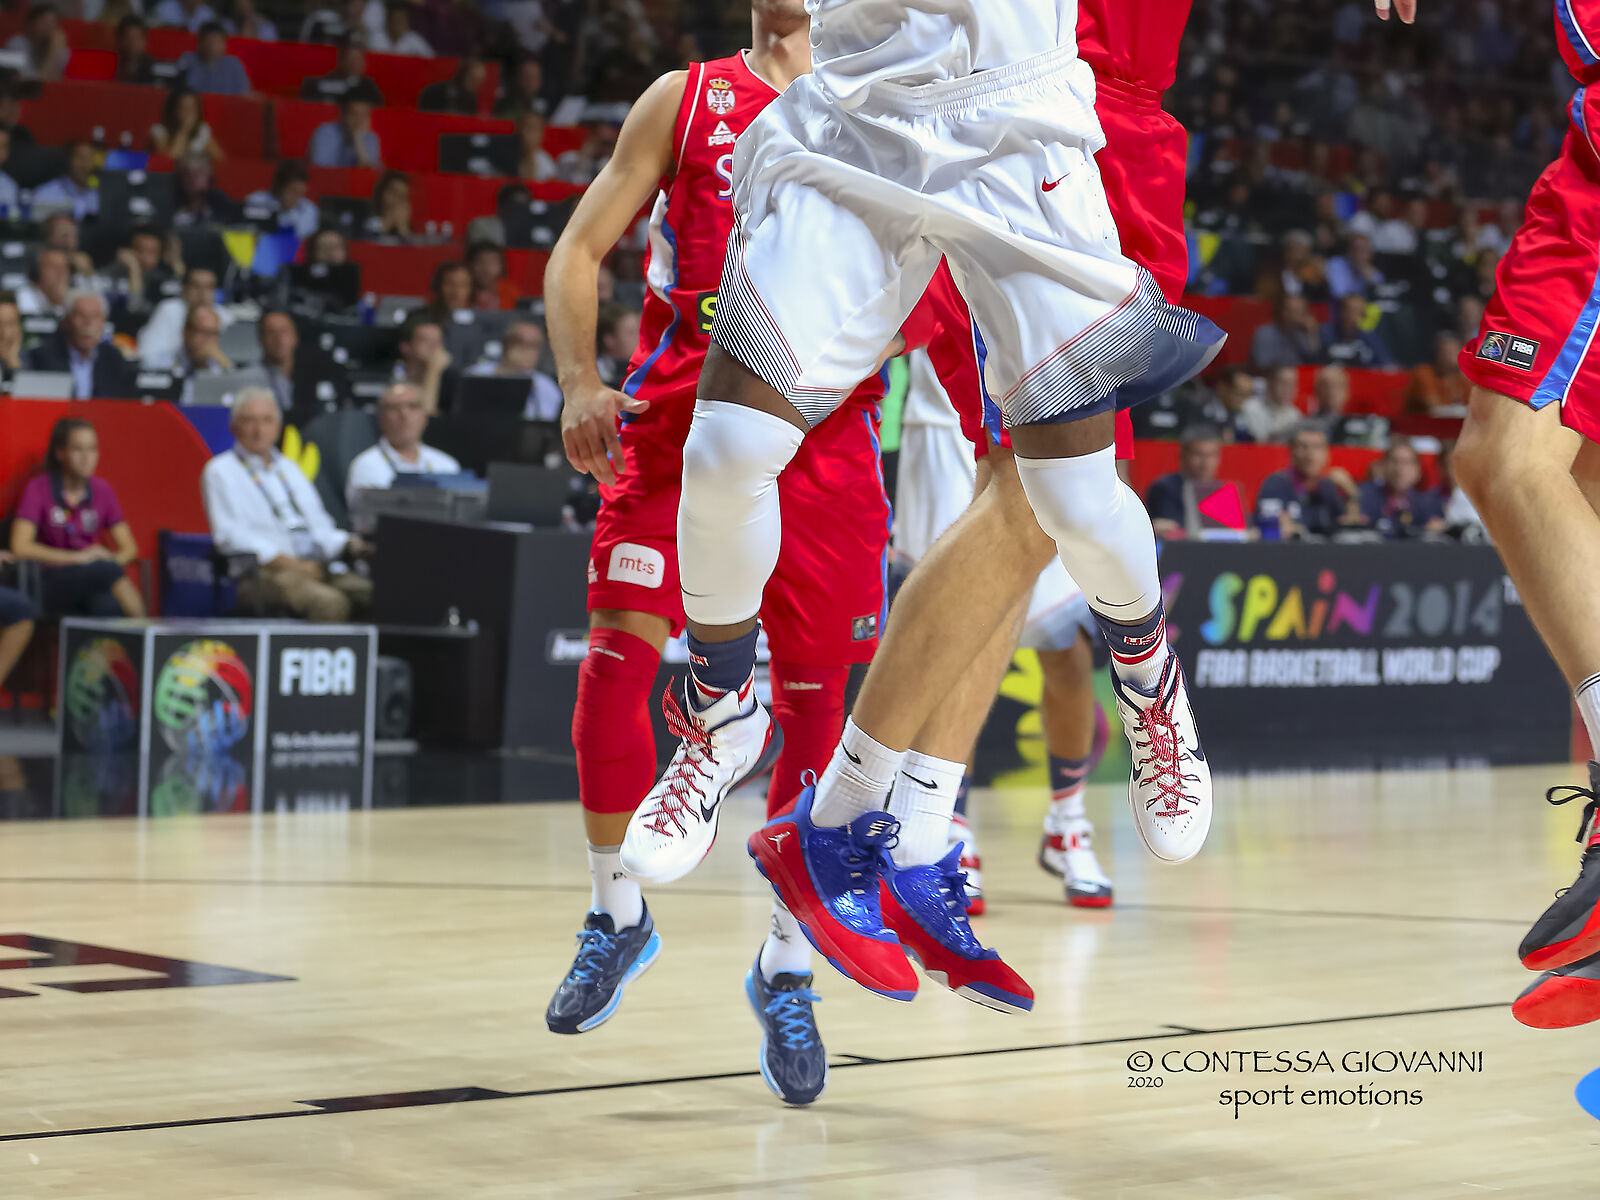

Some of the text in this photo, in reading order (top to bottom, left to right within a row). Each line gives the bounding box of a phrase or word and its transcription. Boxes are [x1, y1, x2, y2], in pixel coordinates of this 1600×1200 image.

[708, 133, 736, 147] PEAK
[1511, 340, 1535, 356] FIBA
[1385, 579, 1502, 638] 2014
[280, 647, 357, 696] FIBA
[1196, 645, 1500, 687] FIBA BASKETBALL WORLD CUP
